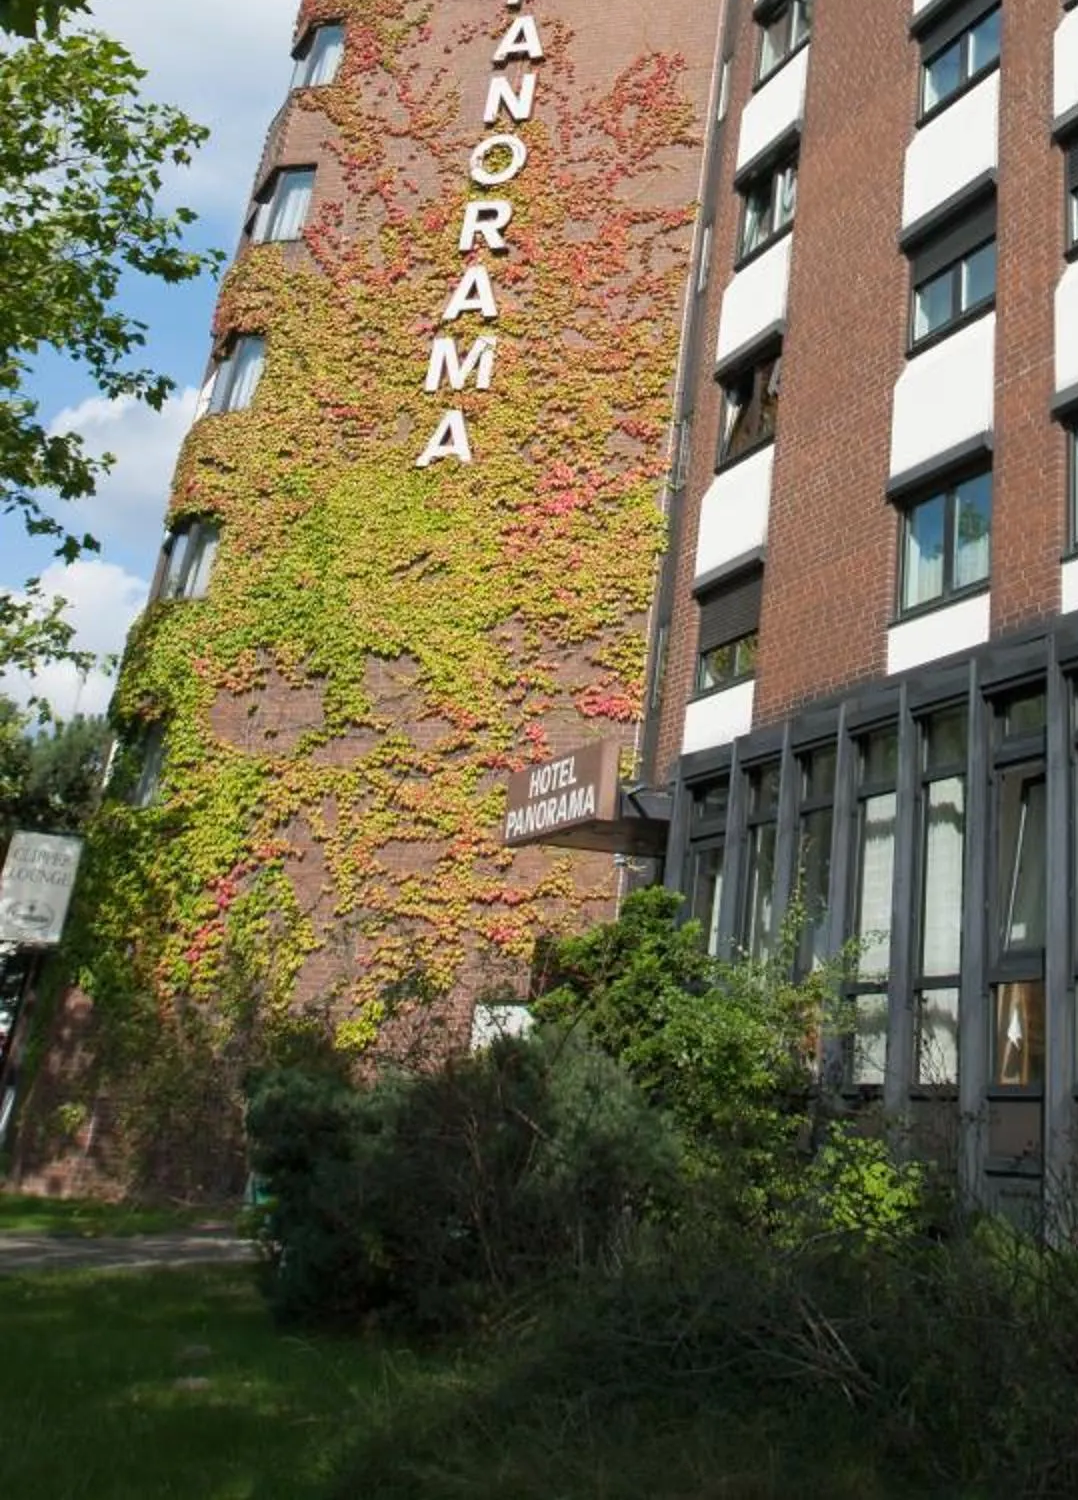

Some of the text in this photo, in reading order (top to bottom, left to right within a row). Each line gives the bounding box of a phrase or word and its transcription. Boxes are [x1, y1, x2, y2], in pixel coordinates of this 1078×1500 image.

[528, 755, 577, 799] HOTEL
[504, 784, 596, 839] PANORAMA
[9, 866, 72, 887] LOUNGE
